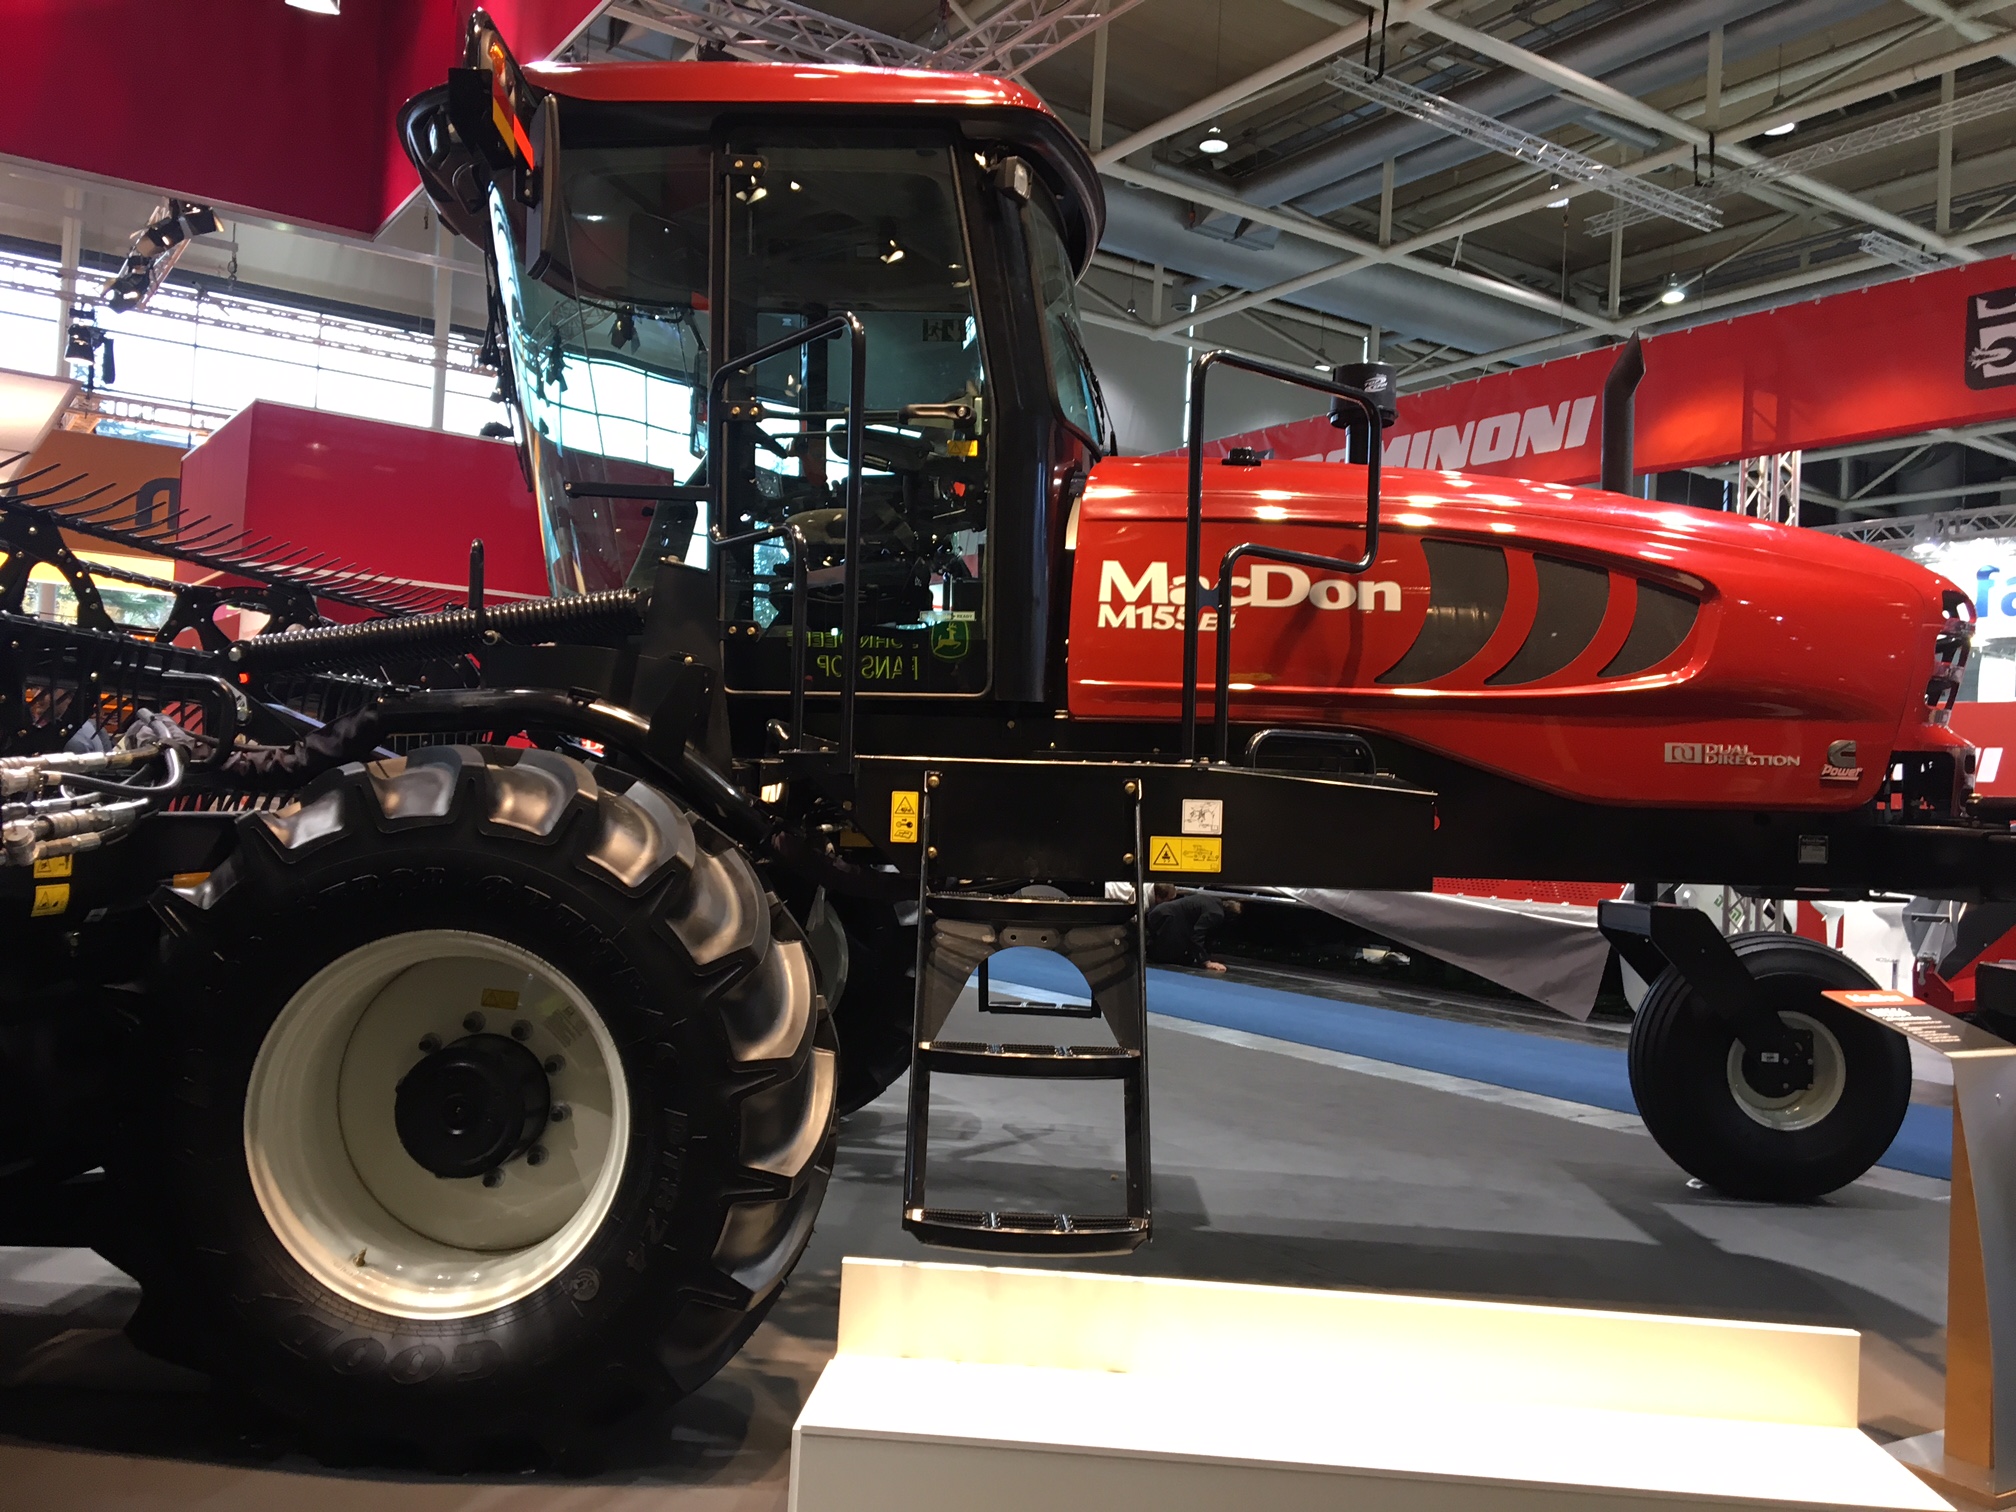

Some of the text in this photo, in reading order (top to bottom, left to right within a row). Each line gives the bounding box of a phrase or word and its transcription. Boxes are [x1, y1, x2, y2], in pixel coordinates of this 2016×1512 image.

[1291, 395, 1597, 470] MINONI
[1098, 560, 1401, 612] MacDon
[1704, 754, 1801, 766] DIRECTION
[1705, 744, 1753, 756] DUAL
